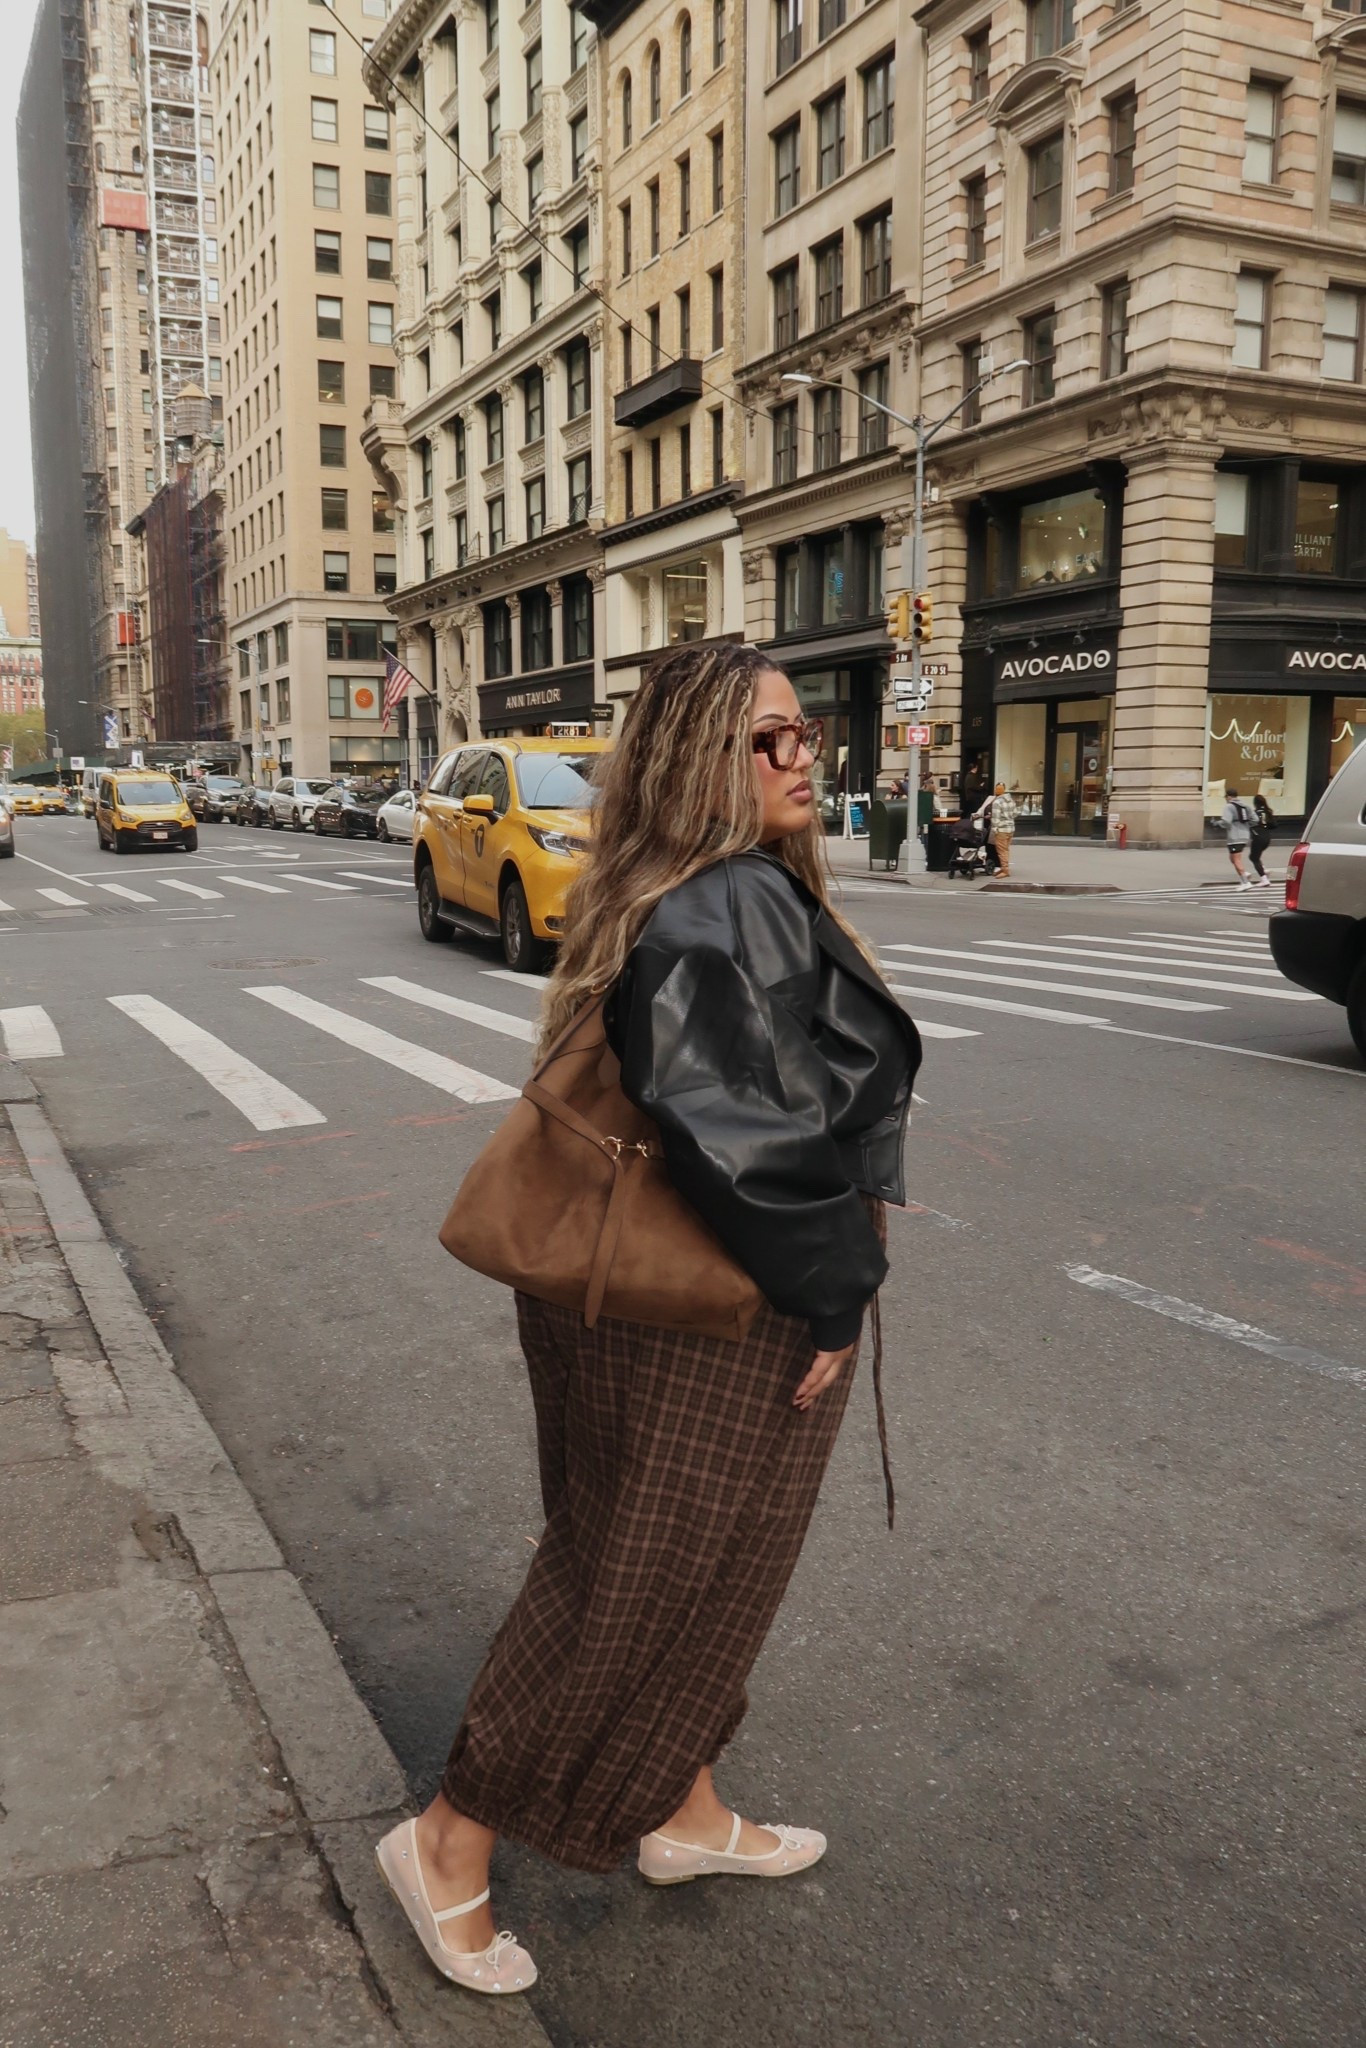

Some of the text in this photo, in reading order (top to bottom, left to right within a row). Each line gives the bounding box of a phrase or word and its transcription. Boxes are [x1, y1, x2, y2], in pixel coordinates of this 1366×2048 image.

[901, 653, 908, 662] Av
[1000, 649, 1111, 679] AVOCADO
[1288, 651, 1366, 670] AVOCA
[924, 665, 947, 674] E 20 St
[505, 688, 562, 709] ANN TAYLOR
[898, 701, 908, 709] ONE
[1233, 729, 1286, 744] Comfort
[1240, 745, 1252, 759] &
